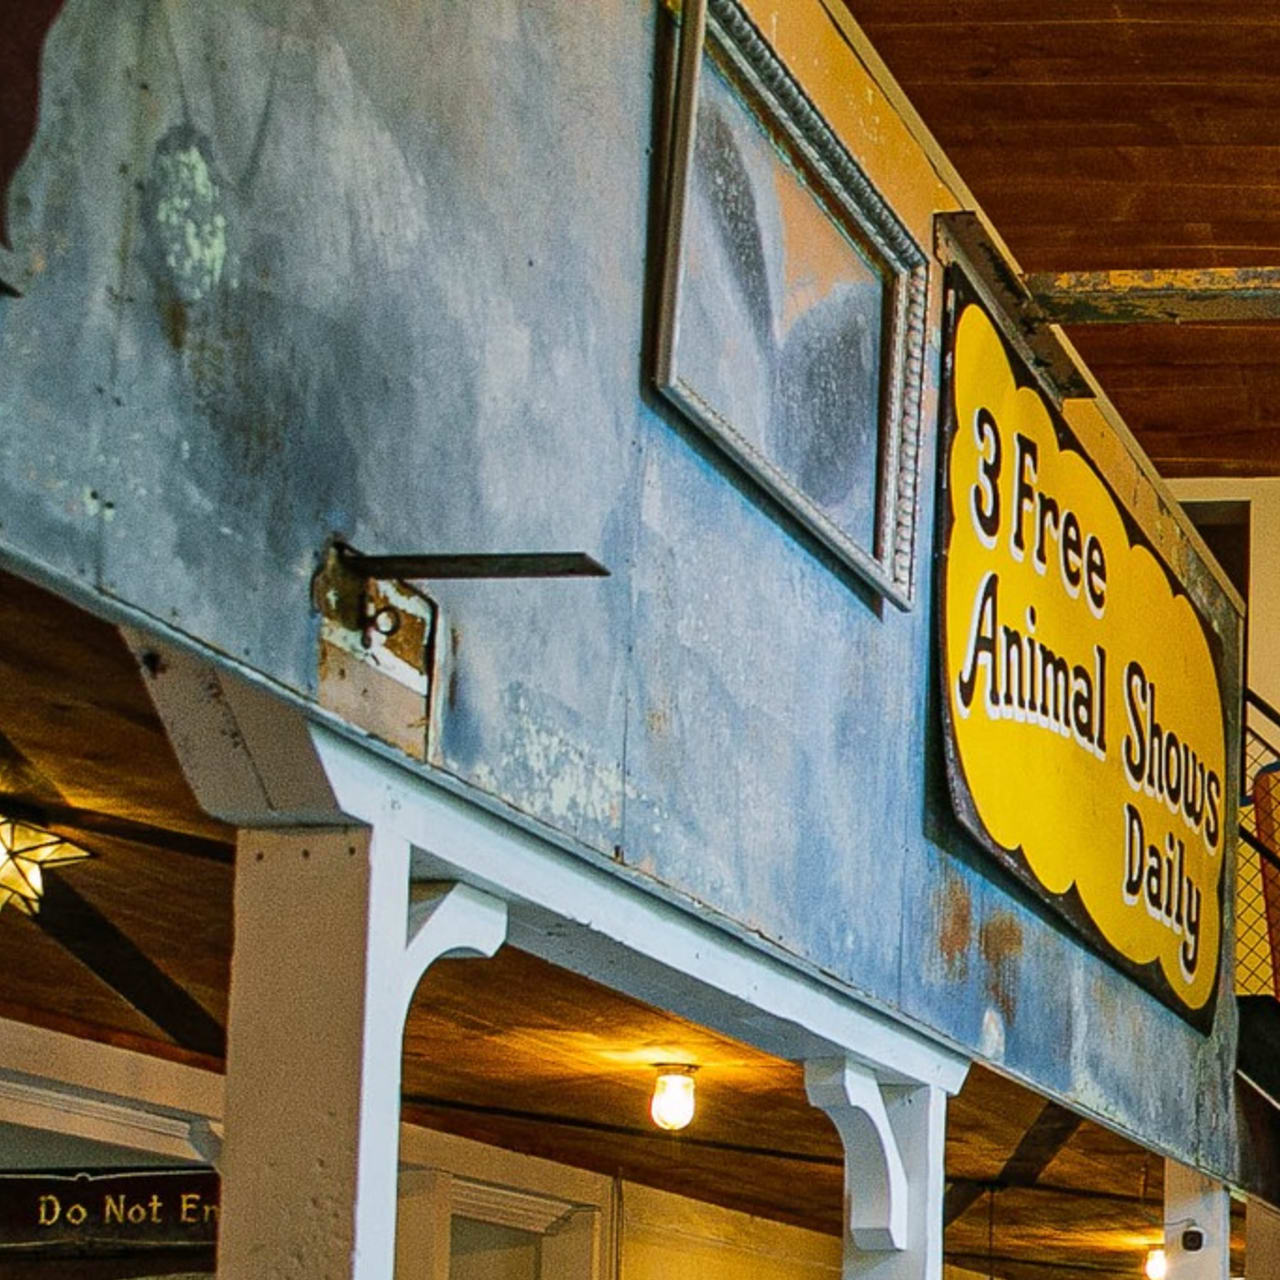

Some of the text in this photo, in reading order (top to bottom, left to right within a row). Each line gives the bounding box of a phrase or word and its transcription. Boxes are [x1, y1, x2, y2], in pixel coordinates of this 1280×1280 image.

[971, 407, 1108, 620] 3 Free
[957, 571, 1221, 856] Animal Shows
[1121, 802, 1203, 983] Daily
[38, 1194, 88, 1226] Do
[104, 1193, 164, 1225] Not
